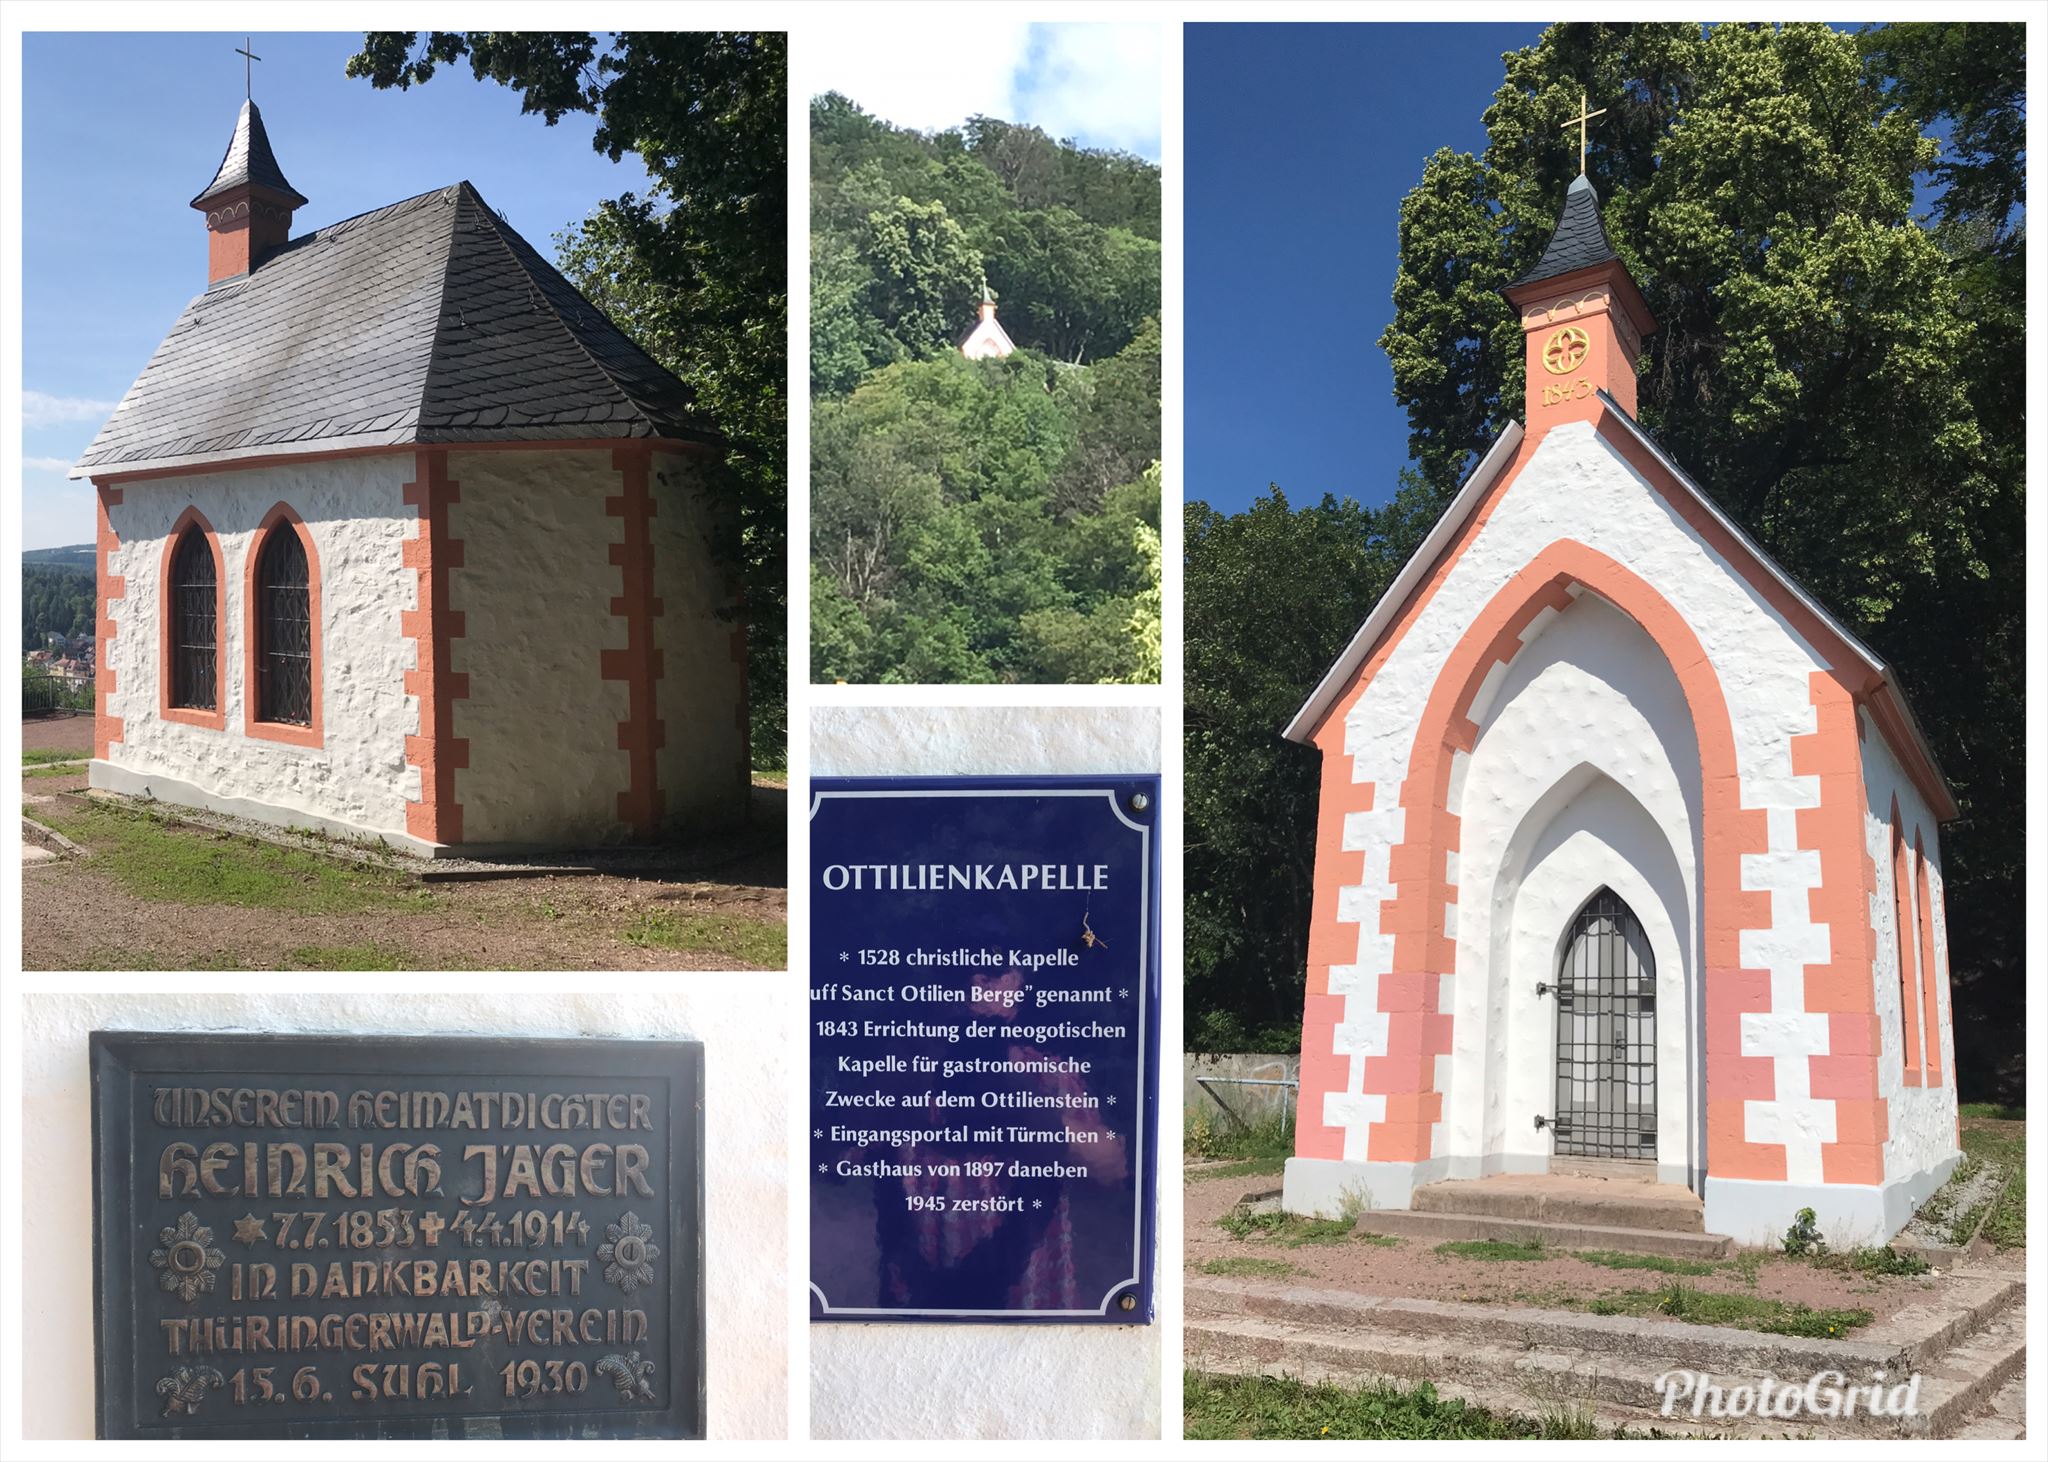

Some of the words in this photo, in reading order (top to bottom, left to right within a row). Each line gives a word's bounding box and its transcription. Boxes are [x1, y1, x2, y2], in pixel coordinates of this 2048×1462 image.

[823, 865, 1108, 890] OTTILIENKAPELLE
[858, 950, 900, 965] 1528
[906, 949, 1003, 966] christliche
[1009, 950, 1079, 971] Kapelle
[842, 985, 895, 1001] Sanct
[901, 985, 965, 1002] Otilien
[1036, 989, 1112, 1007] genannt
[816, 1022, 857, 1037] 1843
[864, 1020, 959, 1043] Errichtung
[966, 1021, 996, 1038] der
[1001, 1022, 1126, 1043] neogotischen
[838, 1056, 907, 1076] Kapelle
[912, 1056, 938, 1072] für
[943, 1057, 1091, 1077] gastronomische
[154, 1088, 340, 1129] UNSEREM
[825, 1091, 895, 1107] Zwecke
[901, 1091, 931, 1107] auf
[936, 1091, 975, 1107] dem
[981, 1092, 1099, 1108] Ottilienstein
[831, 1125, 968, 1147] Eingangsportal
[974, 1127, 1004, 1142] mit
[1007, 1126, 1098, 1143] Türmchen
[159, 1142, 444, 1199] HEINRICH
[459, 1143, 655, 1206] JÄGER
[836, 1160, 921, 1176] Gasthaus
[927, 1165, 960, 1177] von
[964, 1162, 1005, 1176] 1897
[1008, 1162, 1087, 1178] daneben
[906, 1197, 945, 1210] 1945
[952, 1197, 1024, 1212] zerstört
[231, 1262, 276, 1300] IN
[291, 1259, 589, 1298] DANKBARKEIT
[352, 1360, 473, 1401] SUHL
[500, 1359, 588, 1397] 1930
